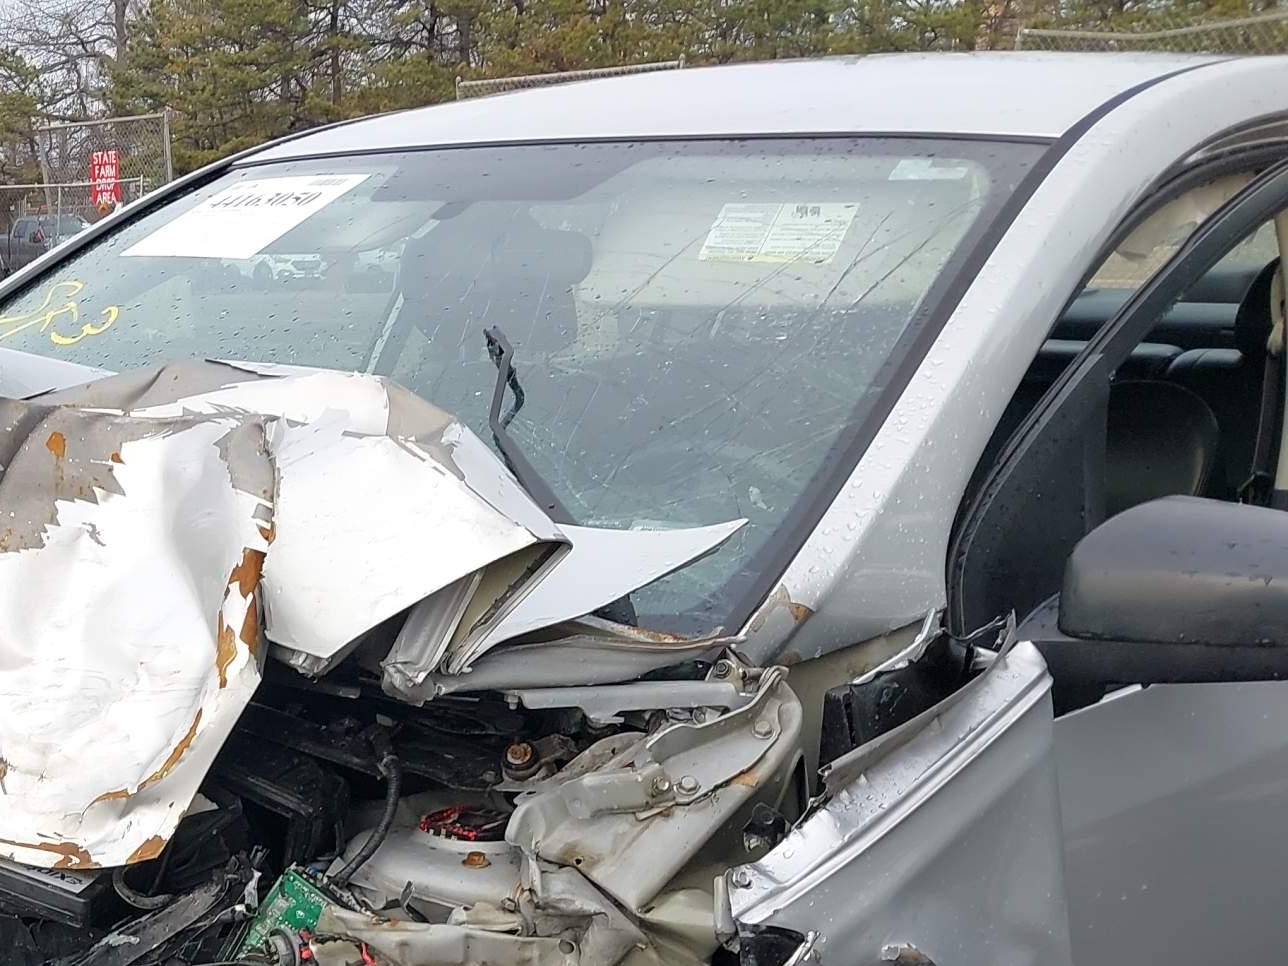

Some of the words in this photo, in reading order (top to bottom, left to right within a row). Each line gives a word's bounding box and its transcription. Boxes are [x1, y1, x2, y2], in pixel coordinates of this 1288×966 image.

[92, 150, 116, 165] STATE
[94, 164, 116, 178] FARM
[95, 178, 115, 191] DROP
[95, 191, 117, 205] AREA
